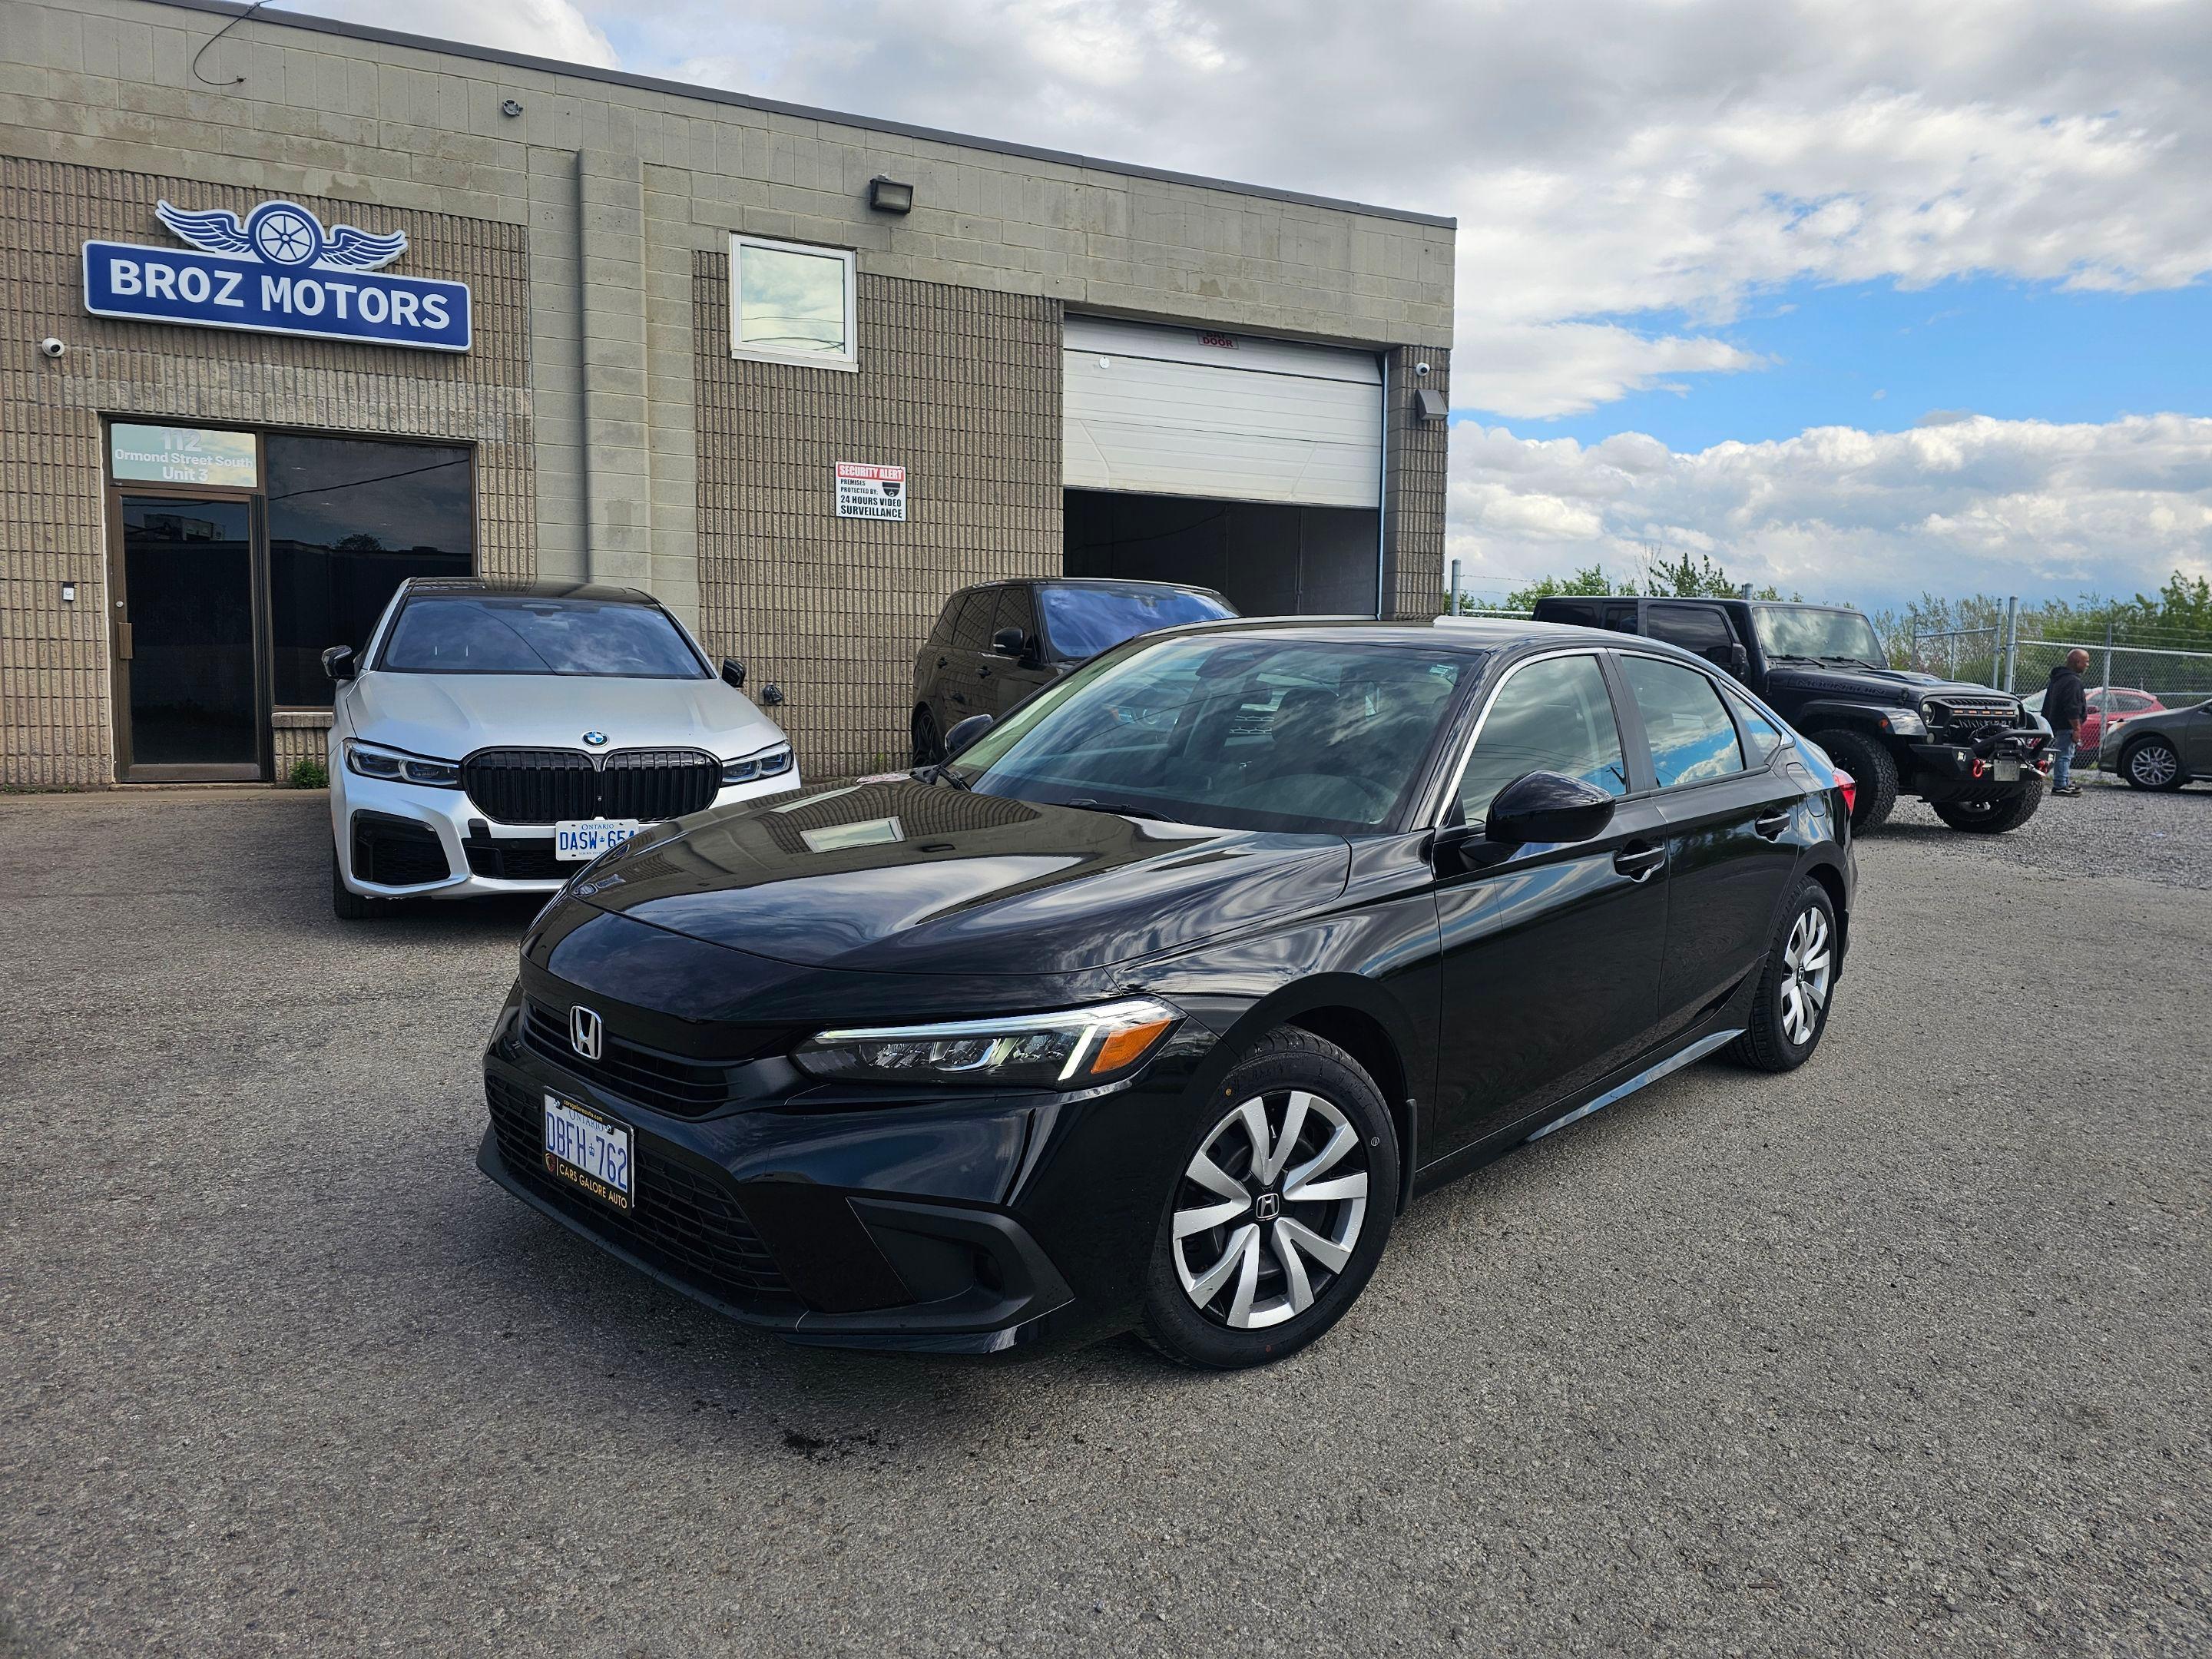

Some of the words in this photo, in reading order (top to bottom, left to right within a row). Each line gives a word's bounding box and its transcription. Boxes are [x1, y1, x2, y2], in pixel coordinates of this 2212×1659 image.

[110, 259, 243, 306] BROZ
[261, 276, 451, 329] MOTORS
[1203, 337, 1233, 347] DOOR
[161, 429, 202, 452] 112
[115, 449, 168, 462] Ormond
[171, 452, 214, 465] Street
[215, 456, 253, 469] South
[163, 467, 195, 481] Unit
[198, 469, 209, 482] 3
[839, 465, 879, 478] SECURITY
[879, 468, 902, 480] ALERT
[840, 495, 850, 503] 24
[852, 496, 877, 505] HOURS
[879, 498, 902, 507] VIDEO
[840, 505, 902, 518] SURVEILLANCE
[546, 1111, 587, 1168] DBFH
[596, 1135, 627, 1190] 762
[559, 1164, 578, 1182] CARS
[579, 1175, 606, 1198] GALORE
[608, 1190, 628, 1209] AUTO
